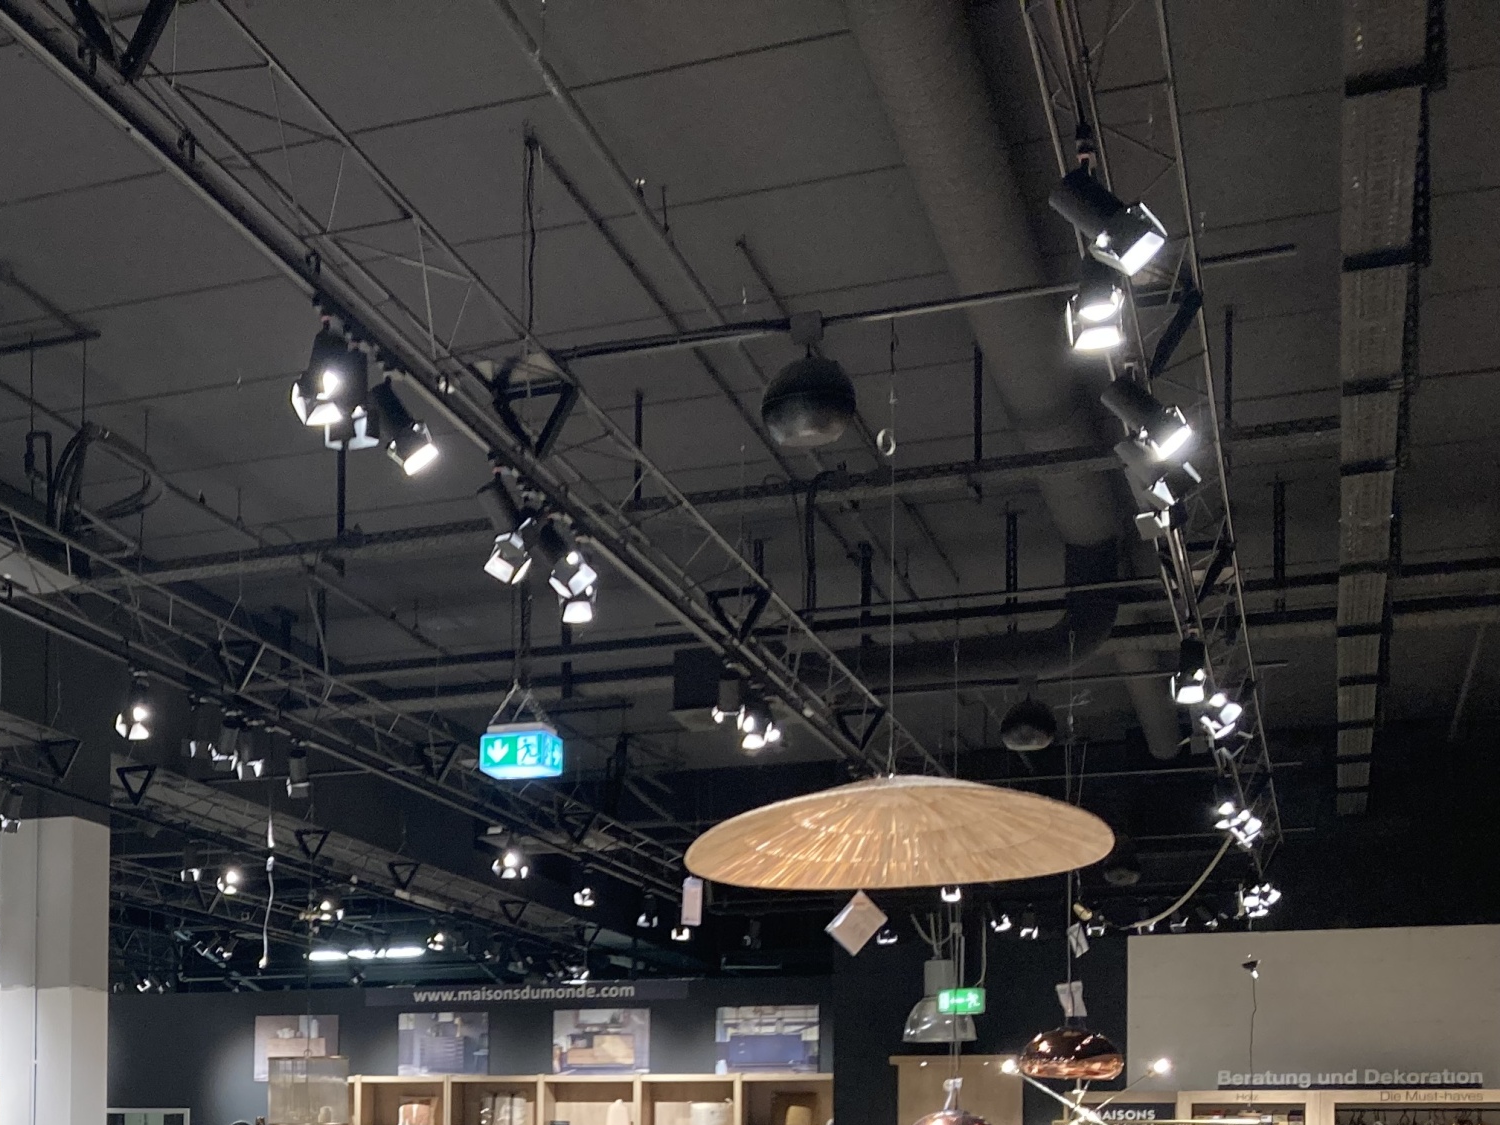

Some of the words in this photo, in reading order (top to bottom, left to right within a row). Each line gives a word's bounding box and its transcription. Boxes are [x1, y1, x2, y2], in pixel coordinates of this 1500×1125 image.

[413, 984, 635, 1002] www.maisonsdumonde.com
[1217, 1069, 1311, 1088] Beratung
[1318, 1069, 1357, 1085] und
[1364, 1068, 1483, 1085] Dekoration
[1380, 1091, 1401, 1102] Die
[1405, 1090, 1484, 1102] Must-haves
